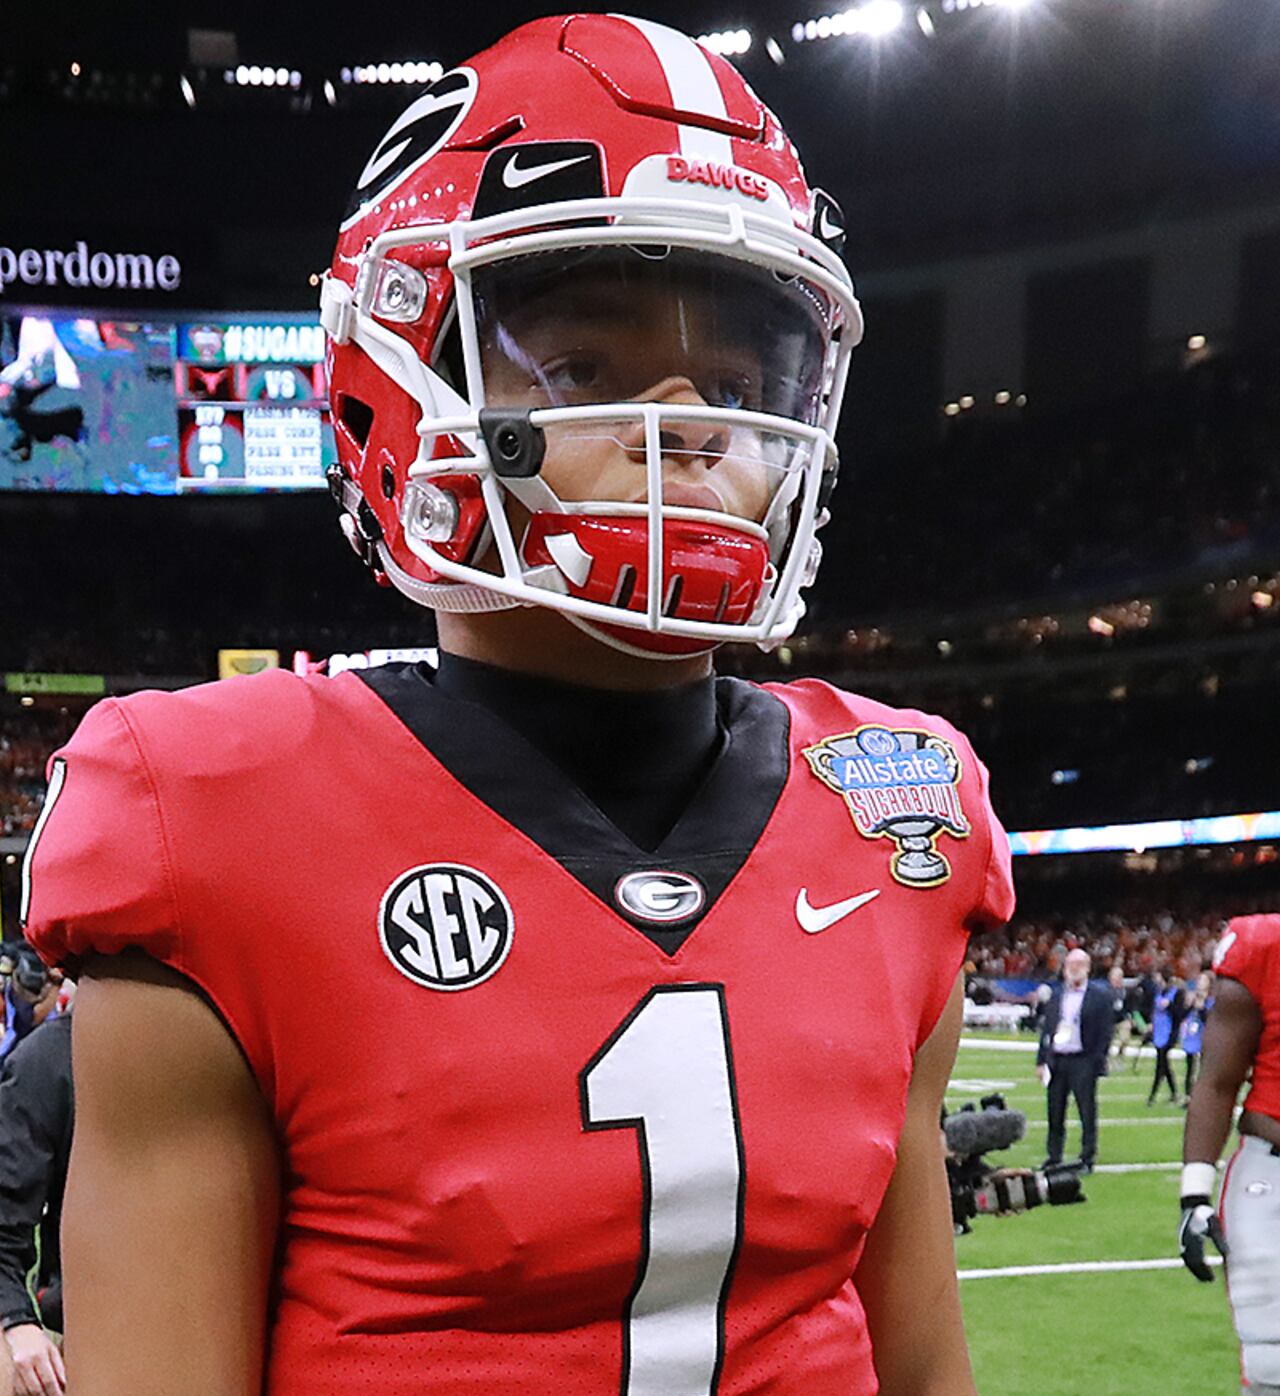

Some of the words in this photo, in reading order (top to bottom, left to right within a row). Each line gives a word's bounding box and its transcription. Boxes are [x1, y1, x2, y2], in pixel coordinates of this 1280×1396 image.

[666, 157, 769, 202] DAWGS
[844, 753, 941, 786] Allstate
[618, 869, 703, 922] G
[390, 873, 500, 980] SEC
